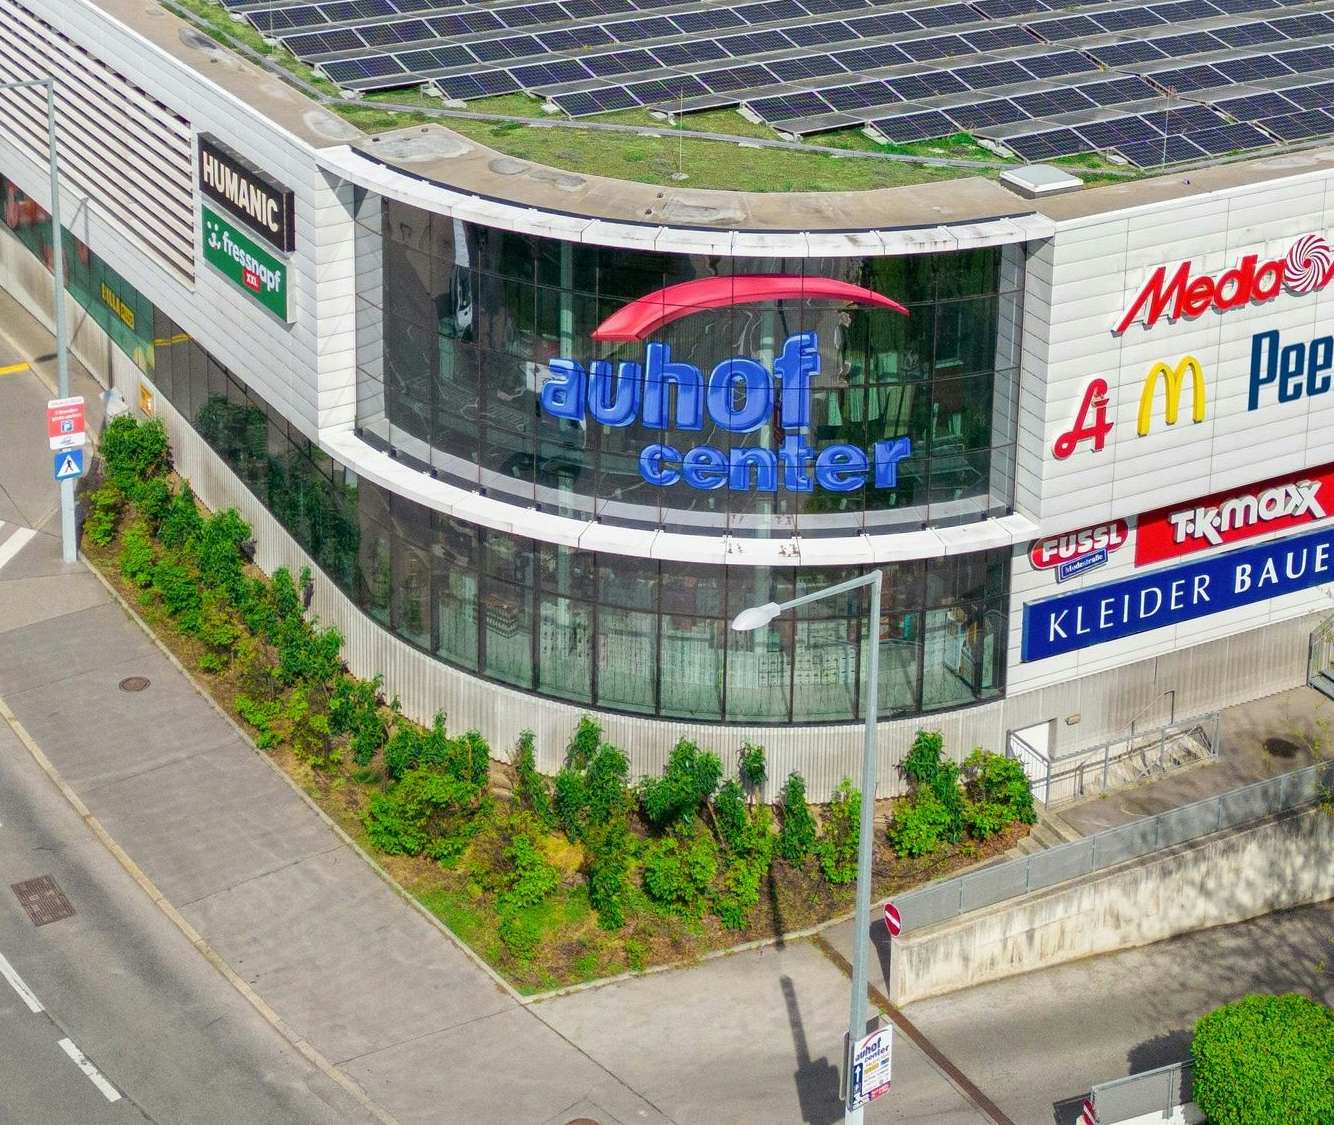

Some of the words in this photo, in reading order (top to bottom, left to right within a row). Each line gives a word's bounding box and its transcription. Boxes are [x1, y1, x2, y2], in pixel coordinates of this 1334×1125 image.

[202, 150, 280, 233] HUMANIC
[222, 231, 282, 293] fressnapf
[245, 272, 259, 287] XXL
[1110, 254, 1287, 338] Media
[540, 329, 823, 434] auhof
[638, 434, 912, 494] center
[1042, 523, 1123, 563] FUSSL
[1064, 553, 1104, 574] Modestraße
[1048, 574, 1211, 643] KLEIDER
[855, 1037, 882, 1062] auhof
[864, 1045, 890, 1063] center
